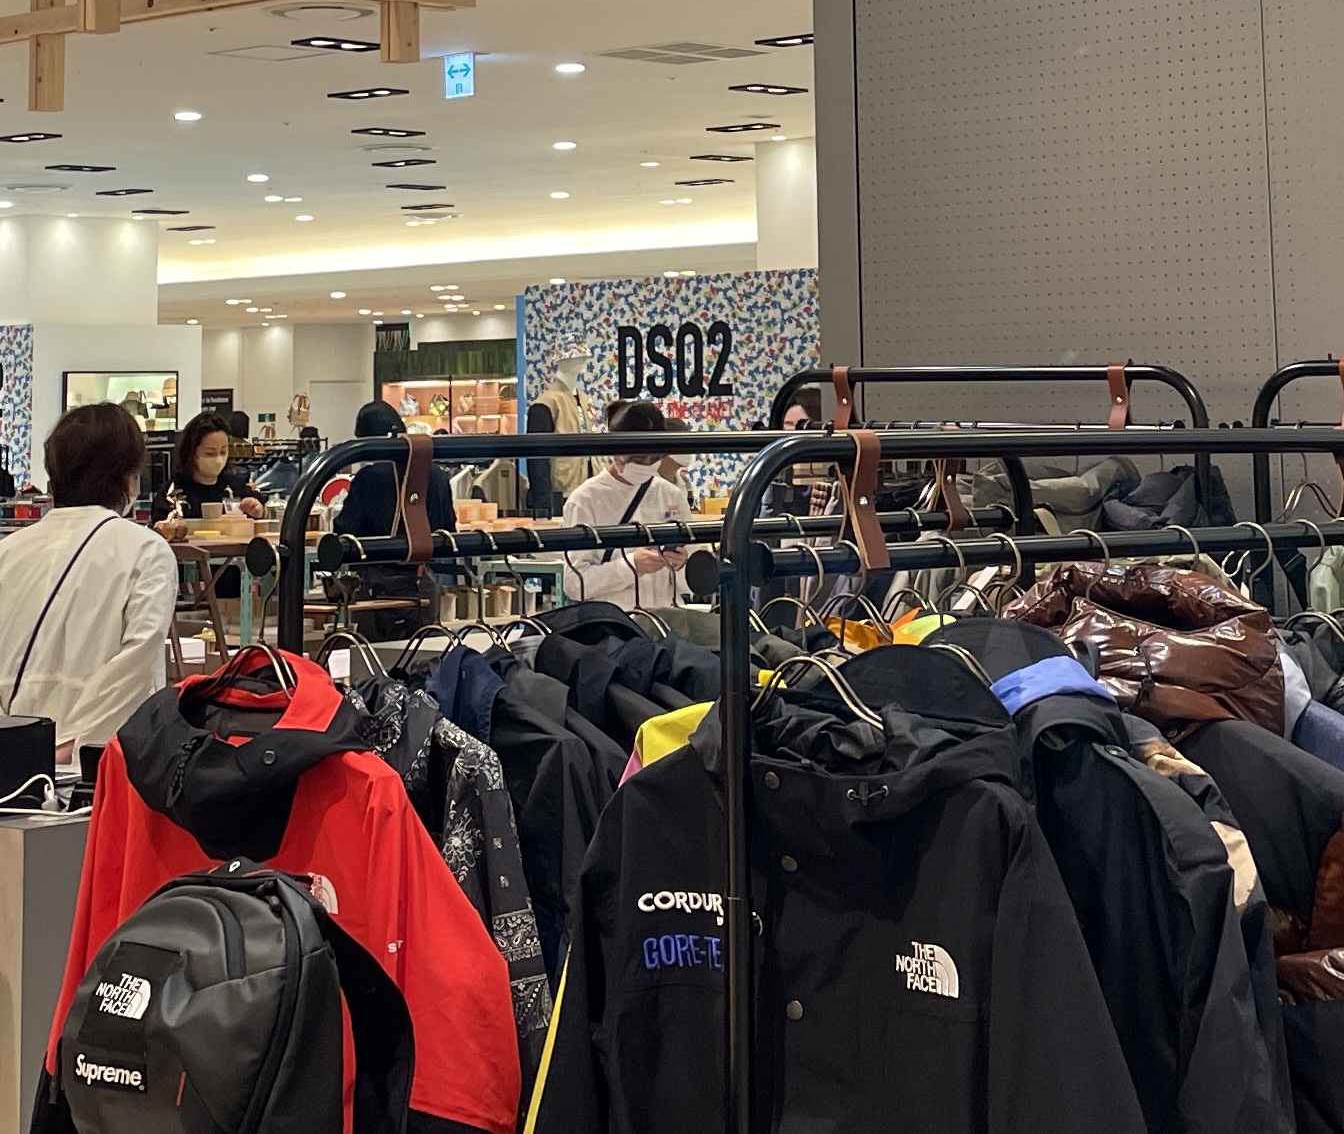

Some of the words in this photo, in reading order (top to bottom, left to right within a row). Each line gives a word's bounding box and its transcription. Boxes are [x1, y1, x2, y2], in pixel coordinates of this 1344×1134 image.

[618, 320, 733, 399] DSQ2
[638, 891, 724, 917] CORDUR
[643, 934, 724, 972] GORE-TE
[911, 941, 935, 961] THE
[896, 954, 936, 977] NORTH
[96, 982, 136, 1004] NORTH
[119, 973, 143, 991] THE
[906, 972, 937, 993] FACE
[99, 997, 129, 1016] FACE
[76, 1053, 142, 1086] Supreme
